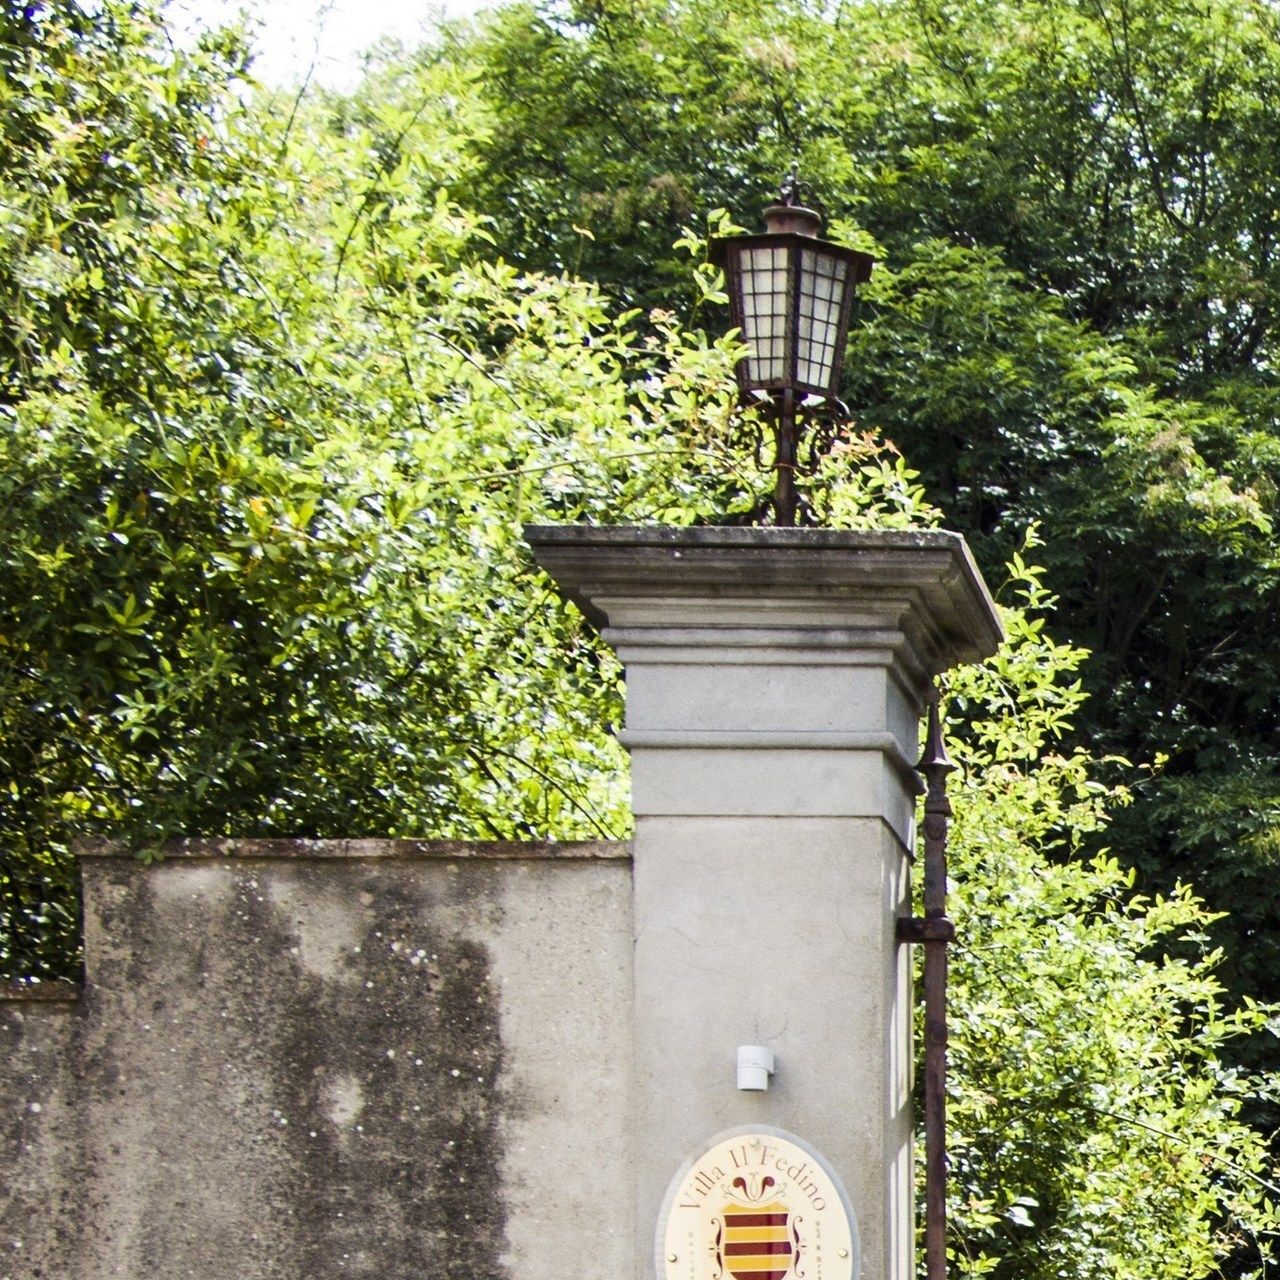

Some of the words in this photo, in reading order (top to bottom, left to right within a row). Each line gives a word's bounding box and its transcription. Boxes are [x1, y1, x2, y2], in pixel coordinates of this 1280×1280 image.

[680, 1164, 726, 1210] Villa
[730, 1144, 749, 1169] Il
[760, 1144, 827, 1212] Fedino
